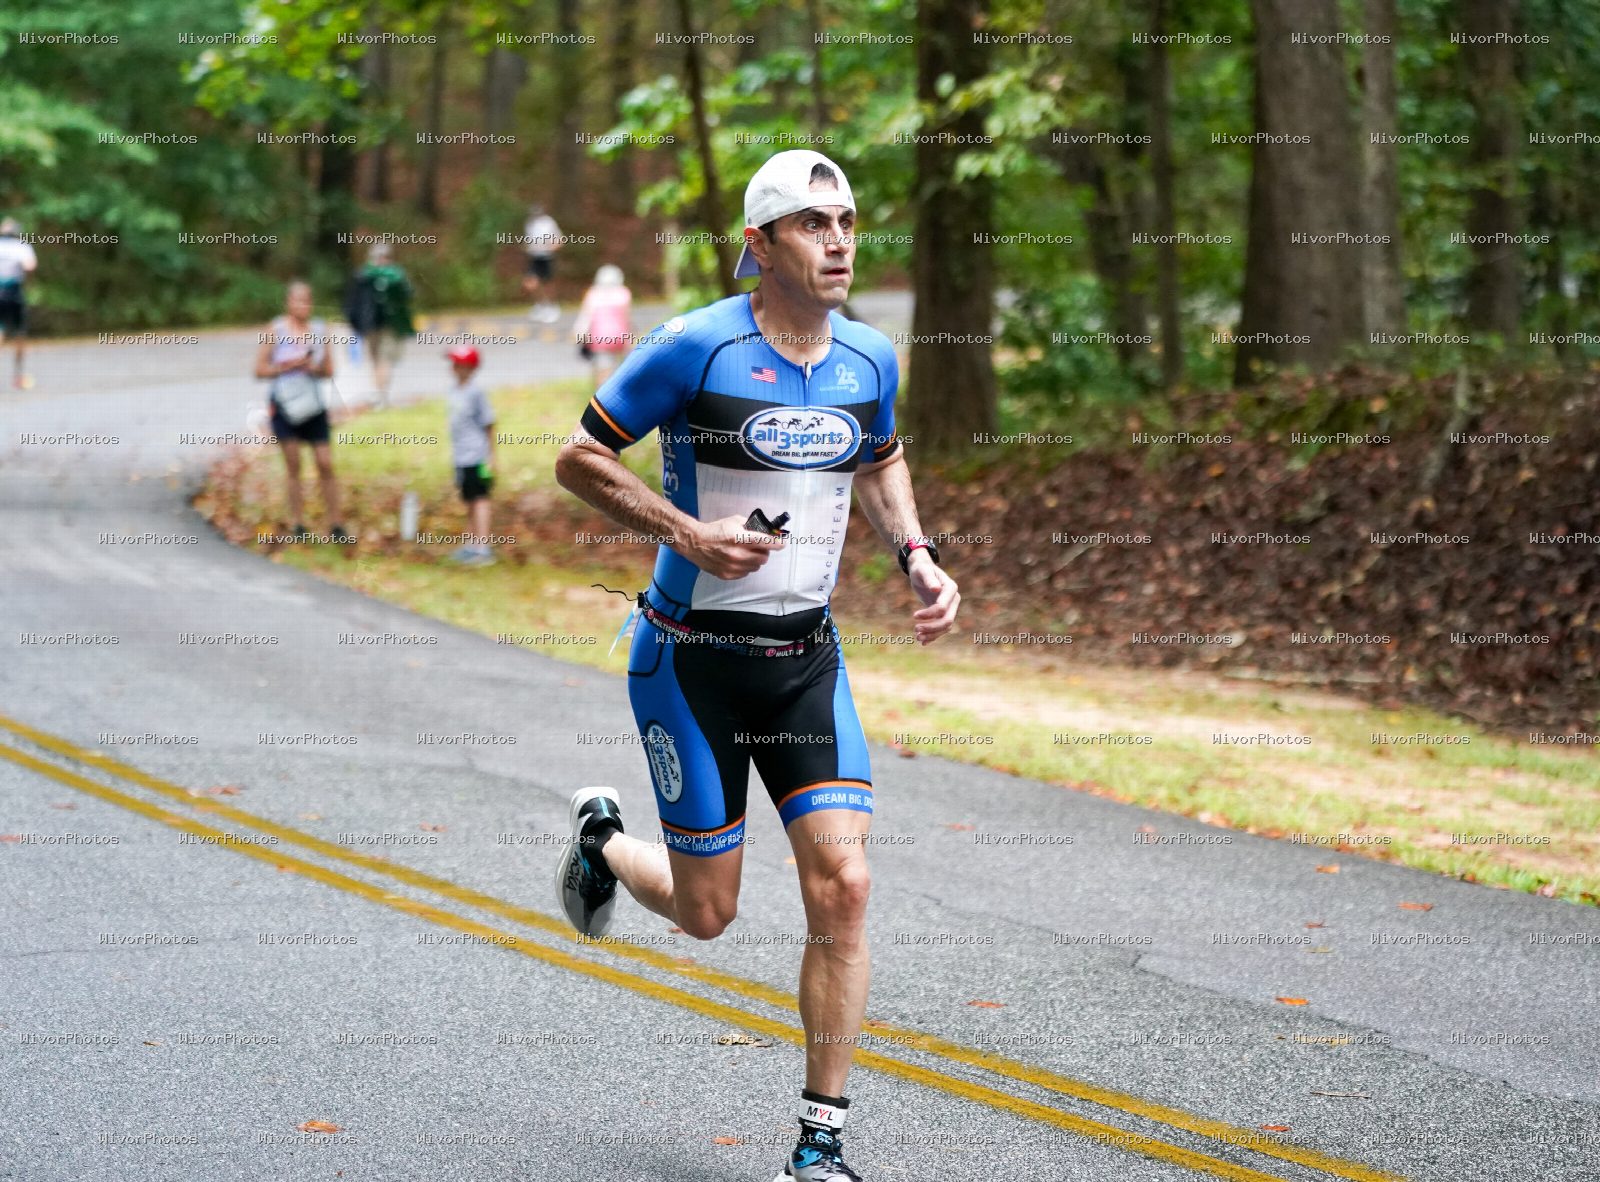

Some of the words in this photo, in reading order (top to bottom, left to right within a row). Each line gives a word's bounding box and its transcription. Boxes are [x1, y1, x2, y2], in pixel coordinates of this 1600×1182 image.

[835, 362, 860, 393] 25
[754, 427, 845, 449] all3sports
[817, 549, 836, 592] RACE
[832, 486, 846, 536] TEAM
[811, 793, 847, 806] DREAM
[848, 793, 863, 805] BIG.
[691, 838, 726, 852] DREAM
[806, 1105, 834, 1121] MYL
